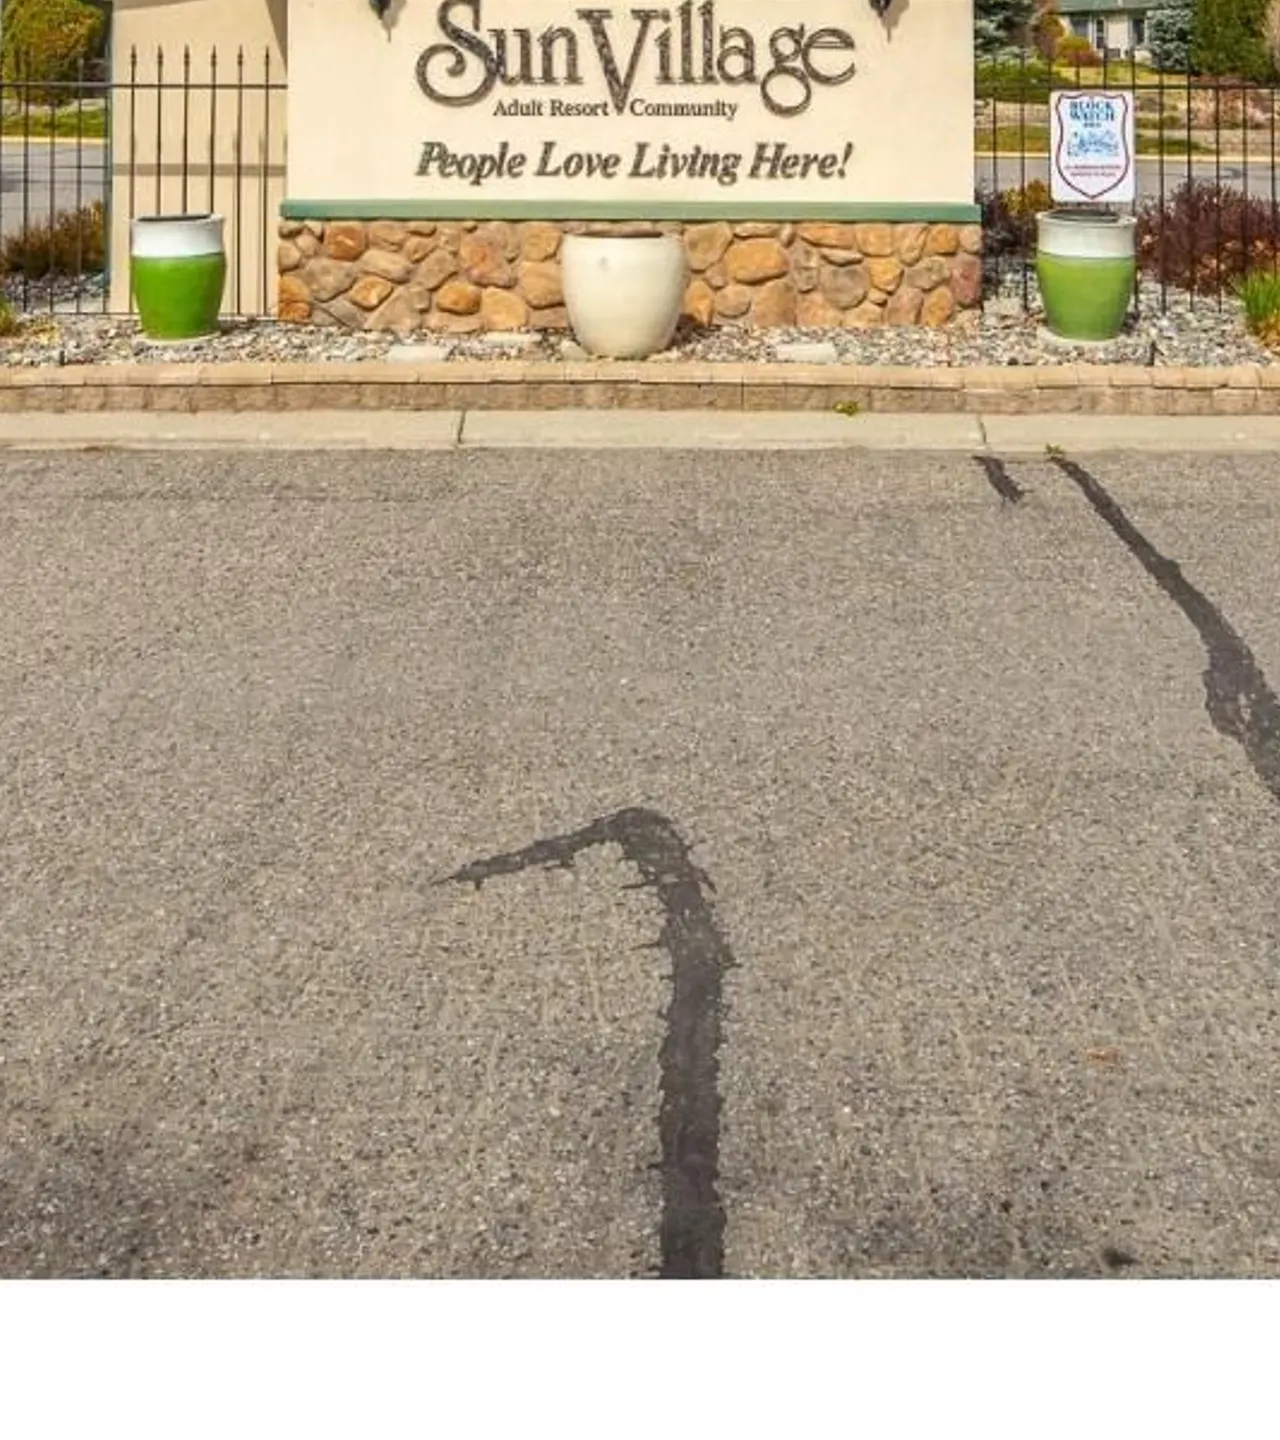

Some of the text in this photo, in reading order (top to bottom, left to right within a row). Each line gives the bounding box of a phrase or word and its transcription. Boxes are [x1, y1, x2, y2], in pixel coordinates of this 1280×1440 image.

[493, 98, 738, 121] Adult Resort Community
[415, 141, 854, 187] People Love Living Here!
